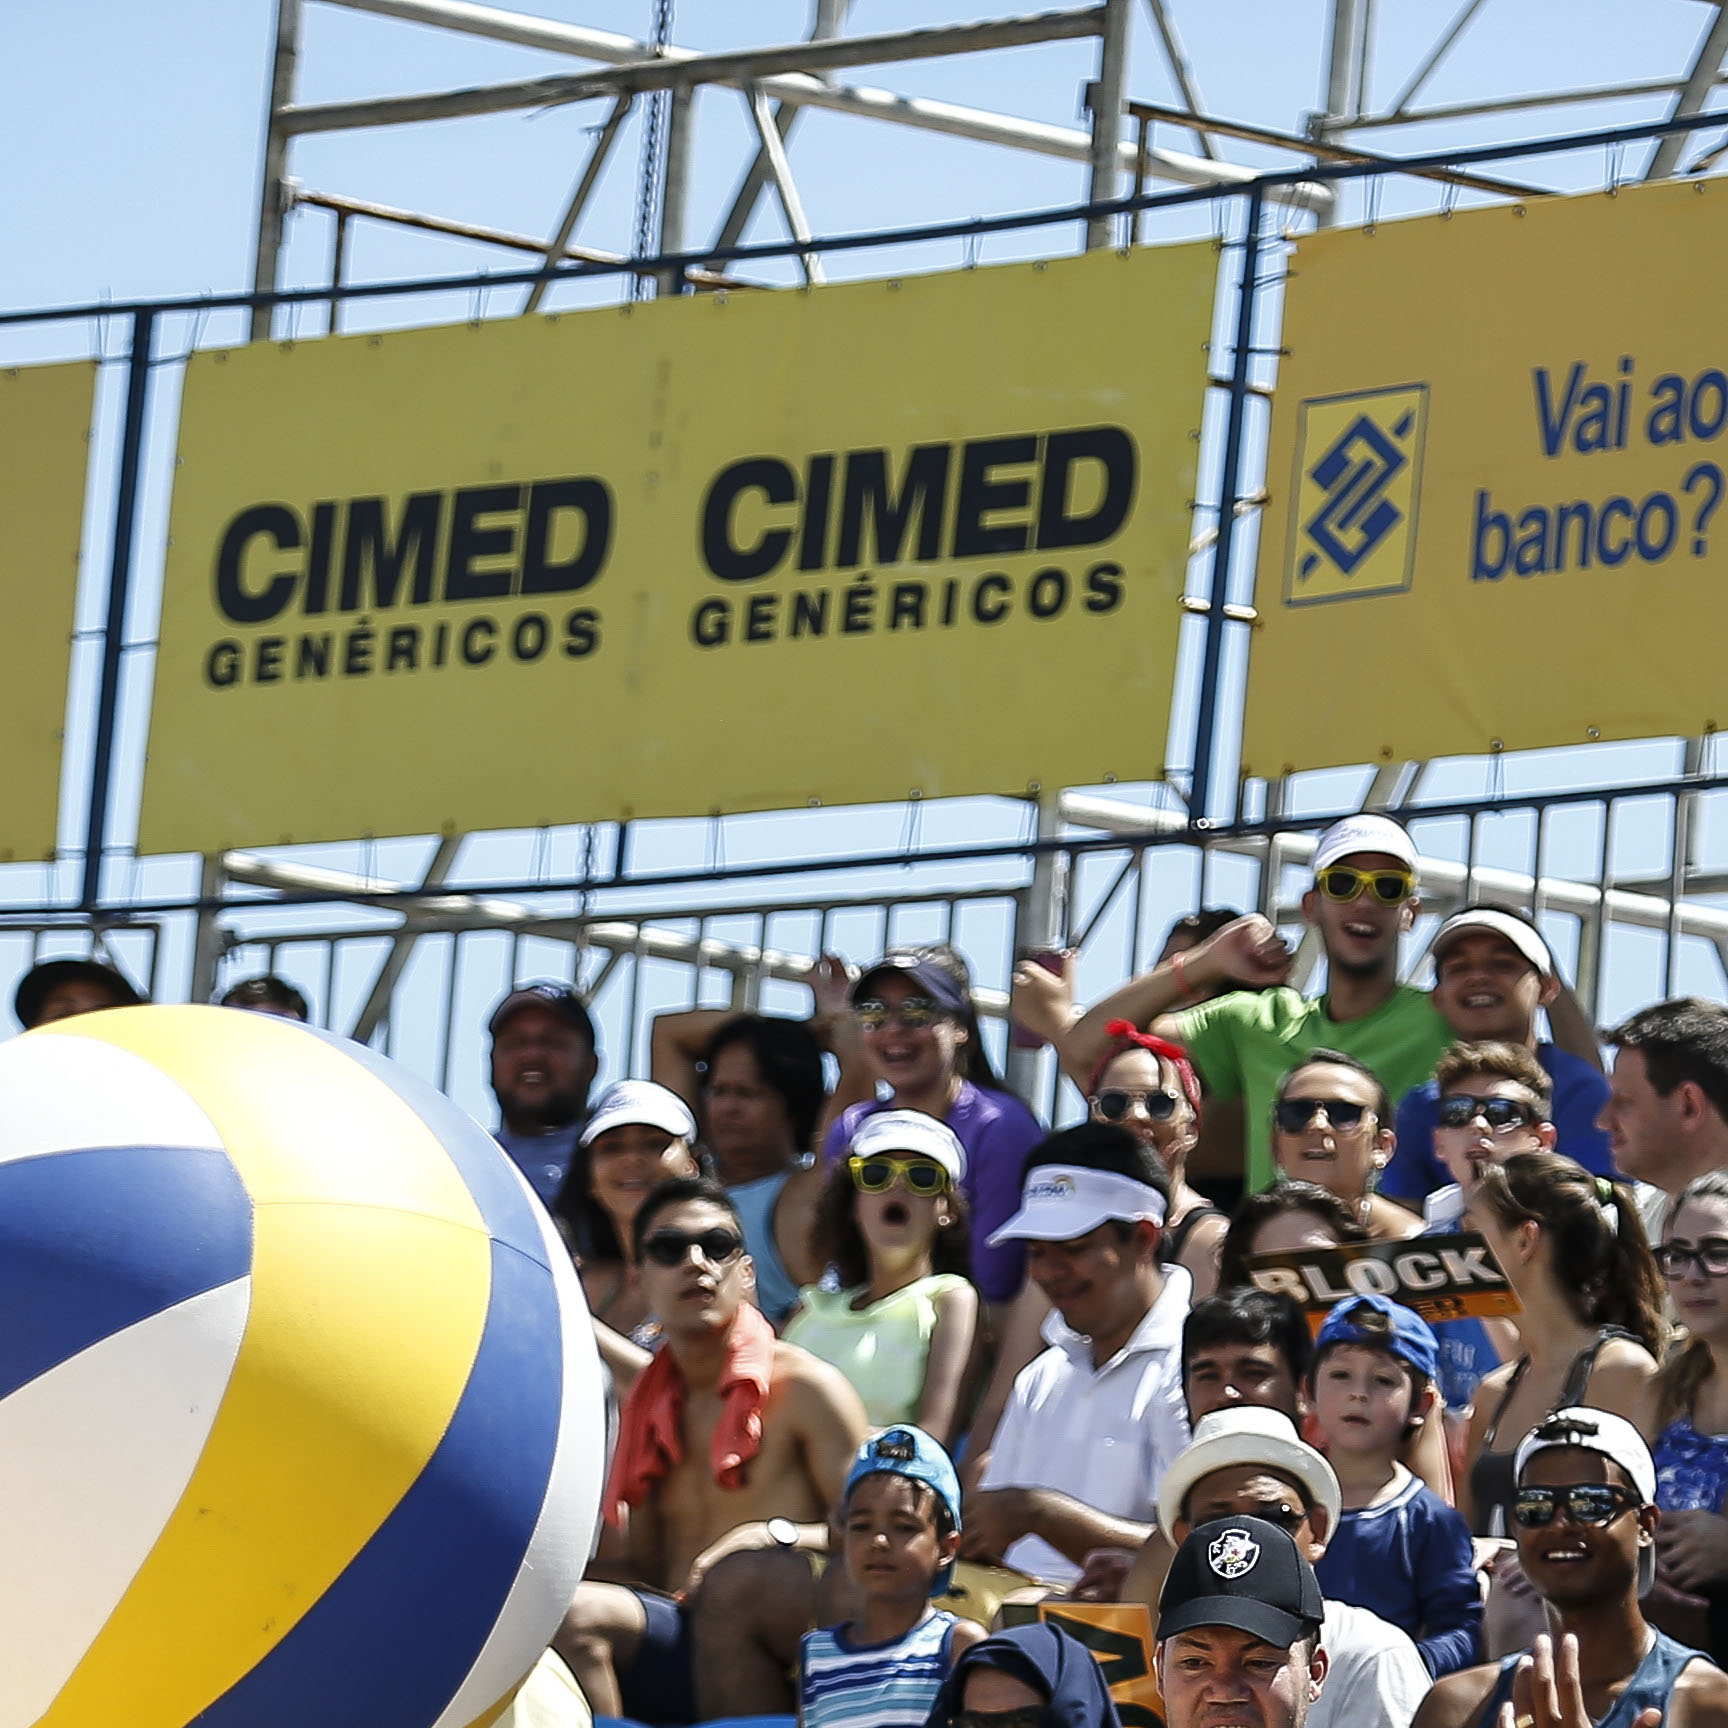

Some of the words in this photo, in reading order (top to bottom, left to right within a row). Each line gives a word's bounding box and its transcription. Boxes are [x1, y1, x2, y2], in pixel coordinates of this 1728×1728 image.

[1532, 353, 1633, 458] Vai
[214, 475, 615, 624] CIMED
[701, 425, 1139, 582] CIMED
[1471, 458, 1727, 583] banco?
[205, 607, 602, 689] GENÉRICOS
[690, 560, 1126, 649] GENÉRICOS
